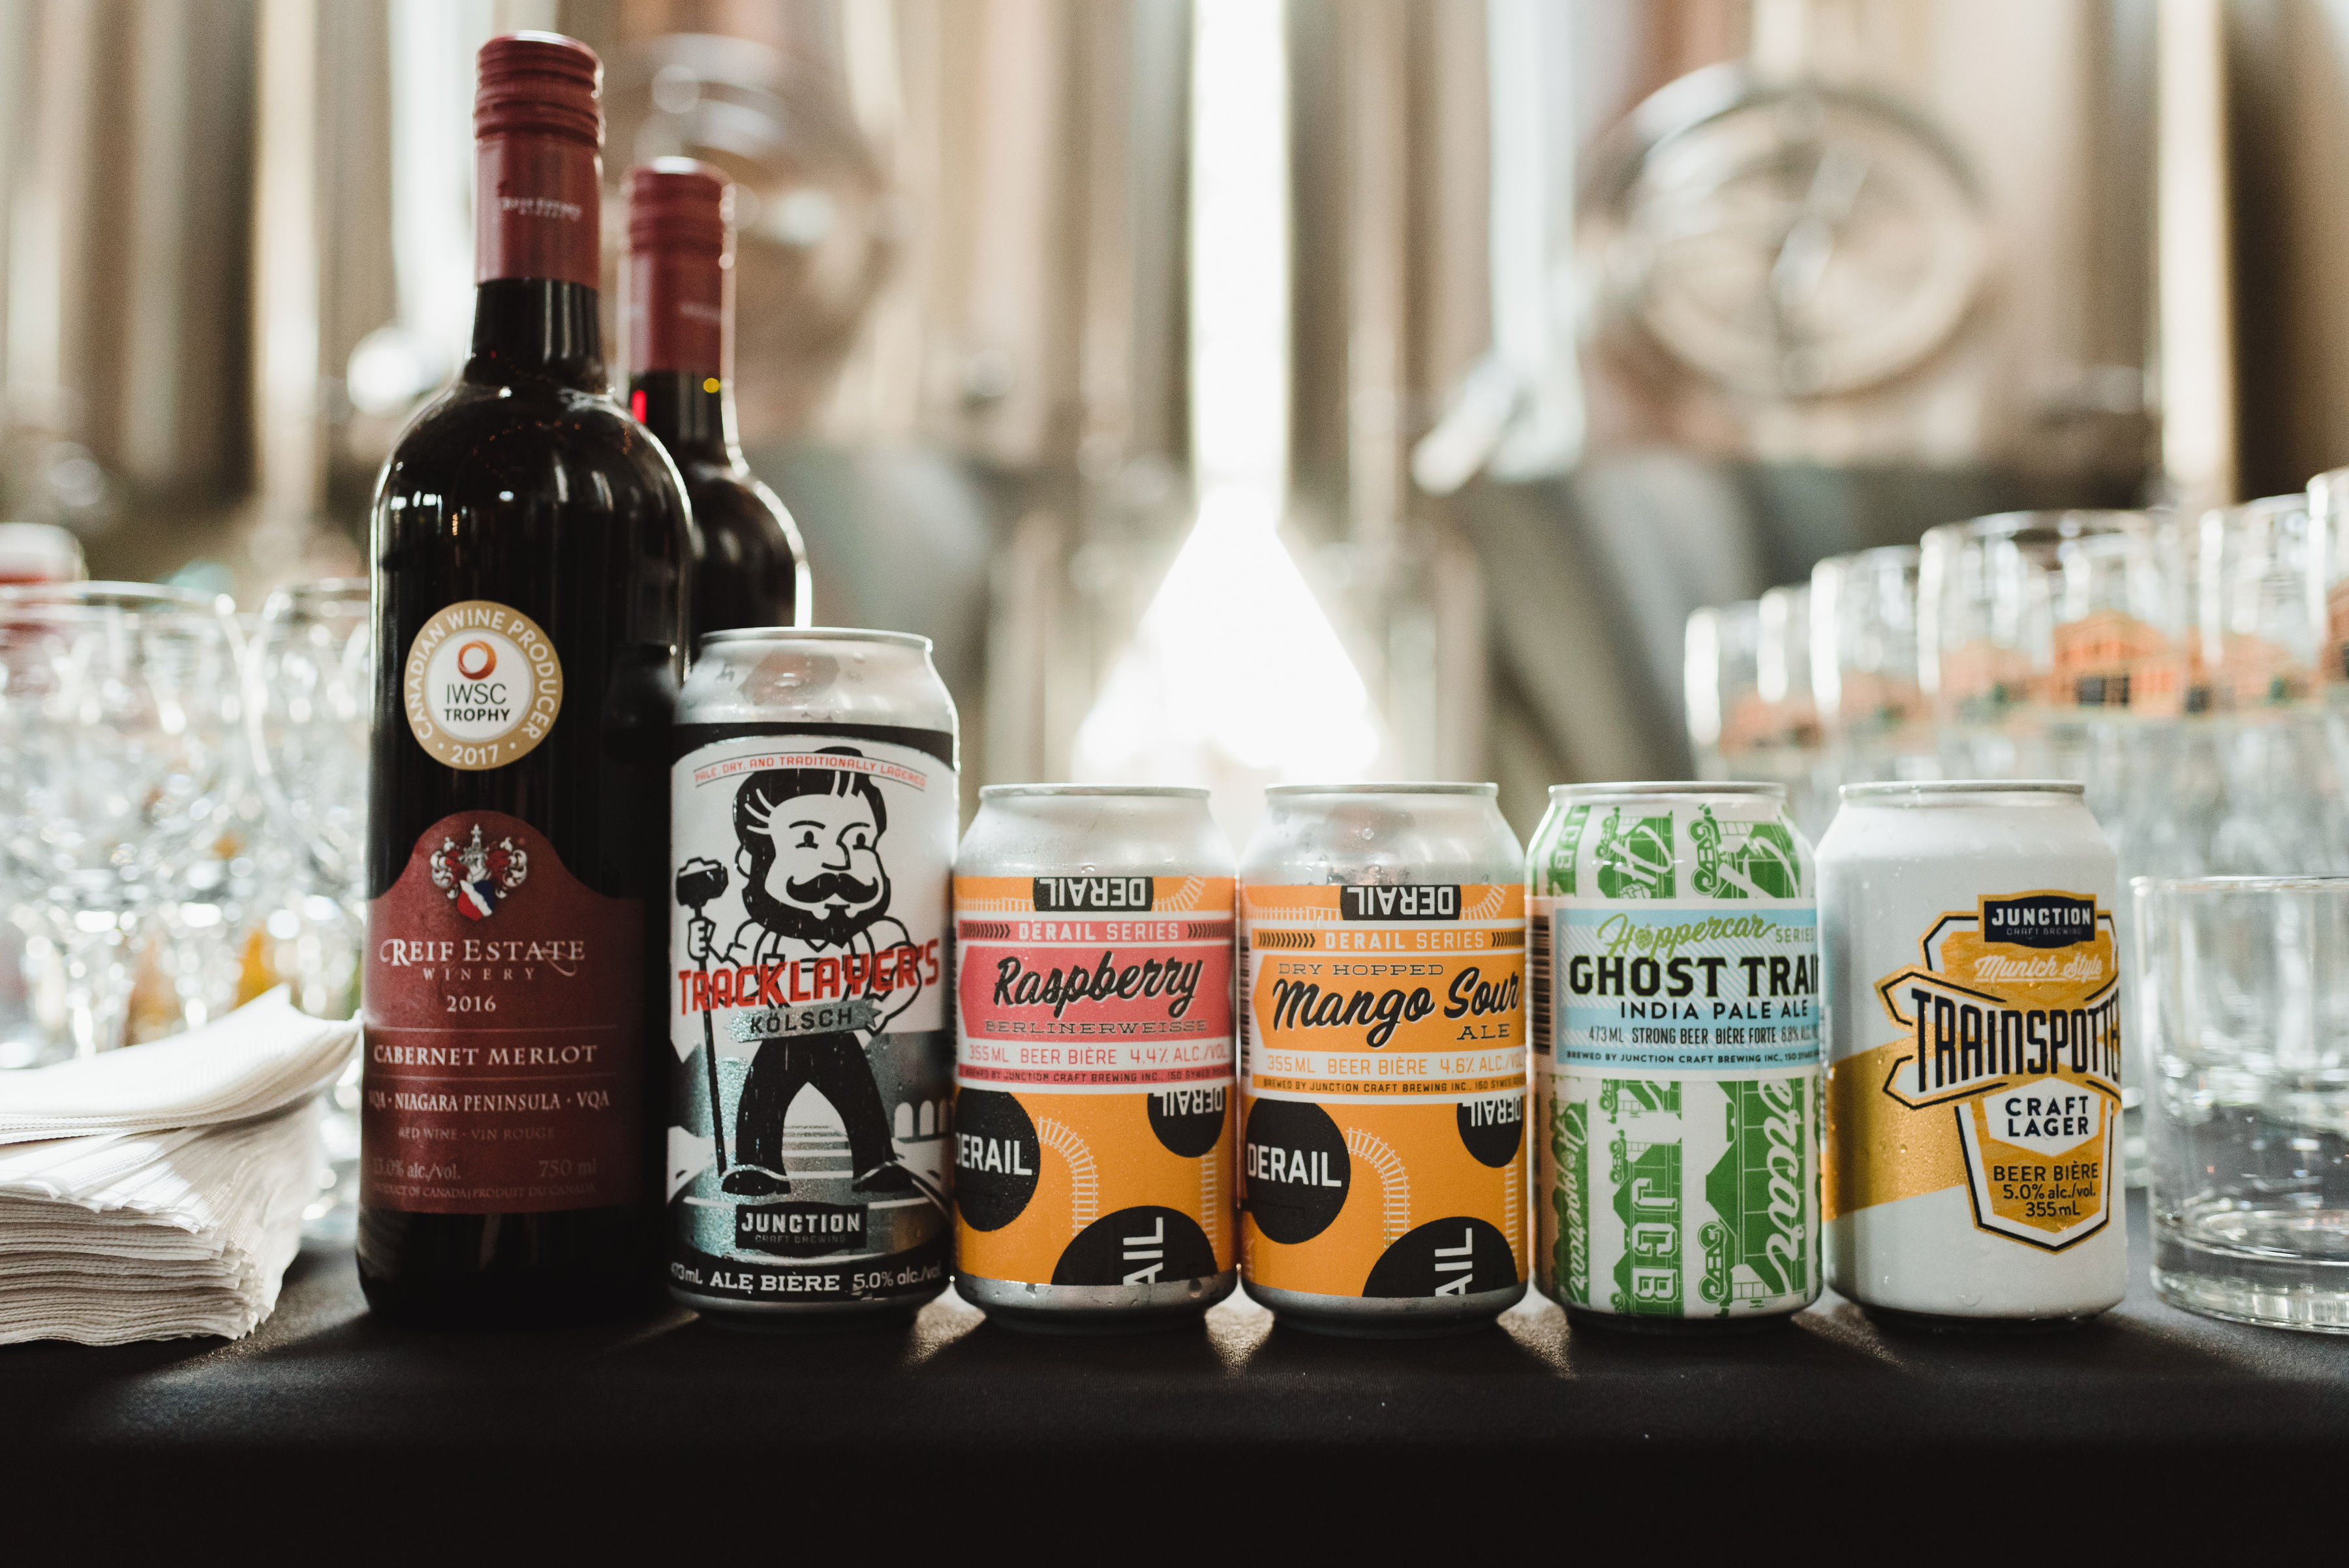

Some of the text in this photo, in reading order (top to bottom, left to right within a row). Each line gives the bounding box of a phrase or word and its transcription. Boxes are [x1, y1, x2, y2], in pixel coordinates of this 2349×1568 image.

[408, 607, 558, 740] CANADIAN WINE PRODUCER
[446, 683, 507, 705] IWSC
[444, 708, 510, 722] TROPHY
[450, 744, 499, 766] 2017
[750, 757, 774, 768] AND
[779, 756, 876, 771] TRADITIONALLY
[1039, 878, 1146, 907] DERAIL
[1347, 886, 1454, 915] DERAIL
[1991, 906, 2091, 926] JUNCTION
[1019, 922, 1179, 941] DERAIL SERIES
[1325, 931, 1484, 949] DERAIL SERIES
[2006, 927, 2040, 936] CRAFT
[380, 938, 587, 966] REIF ESTATE
[423, 968, 535, 981] WINERY
[1278, 962, 1444, 976] DRY HOPPED
[1569, 955, 1728, 998] GHOST
[1975, 953, 2103, 983] Munich Style
[993, 951, 1204, 1020] Raspberry
[446, 995, 497, 1013] 2016
[1272, 967, 1519, 1048] Mango Sour
[1621, 999, 1808, 1019] INDIA PALE ALE
[750, 1007, 852, 1034] KÖLSCH
[985, 1020, 1207, 1035] BERLINERWEISSE
[1456, 1023, 1511, 1041] ALE
[1632, 1027, 1676, 1044] STRONG
[1680, 1028, 1709, 1045] BEER
[1715, 1026, 1745, 1045] BIÈRE
[1749, 1026, 1776, 1044] FORTE
[373, 1043, 598, 1066] CABERNET MERLOT
[1021, 1048, 1060, 1064] BEER
[1068, 1046, 1117, 1065] BIÈRE
[1130, 1048, 1168, 1064] 4.4%
[1567, 1051, 1601, 1061] BREWED
[1620, 1054, 1674, 1064] JUNCTION
[1679, 1055, 1713, 1064] CRAFT
[1718, 1054, 1761, 1064] BREWING
[1328, 1058, 1371, 1075] BEER
[1379, 1056, 1428, 1075] BIÈRE
[1441, 1056, 1475, 1075] 4.6%
[1053, 1073, 1086, 1083] CRAFT
[1091, 1072, 1137, 1083] BREWING
[1263, 1078, 1292, 1090] BREWED
[1296, 1080, 1306, 1090] BY
[1310, 1081, 1359, 1092] JUNCTION
[1364, 1083, 1398, 1093] CRAFT
[1403, 1083, 1447, 1093] BREWING
[394, 1092, 458, 1111] NIAGARA
[464, 1093, 561, 1112] PENINSULA
[576, 1090, 611, 1111] VQA
[1154, 1086, 1223, 1116] DERAIL
[2005, 1096, 2088, 1116] CRAFT
[1462, 1097, 1521, 1127] DERAIL
[423, 1126, 457, 1141] WINE
[470, 1128, 497, 1141] VIN
[503, 1126, 555, 1141] ROUGE
[2008, 1117, 2089, 1137] LAGER
[539, 1157, 598, 1178] 750 ml
[1247, 1143, 1342, 1188] DERAIL
[1993, 1161, 2098, 1182] BEER BIÈRE
[529, 1186, 547, 1196] DU
[2003, 1182, 2096, 1200] 5.0% alc./vol.
[741, 1212, 861, 1233] JUNCTION
[755, 1234, 789, 1243] CRAFT
[710, 1270, 754, 1291] ALE
[760, 1272, 840, 1292] BIÈRE
[853, 1271, 894, 1289] 5.0%
